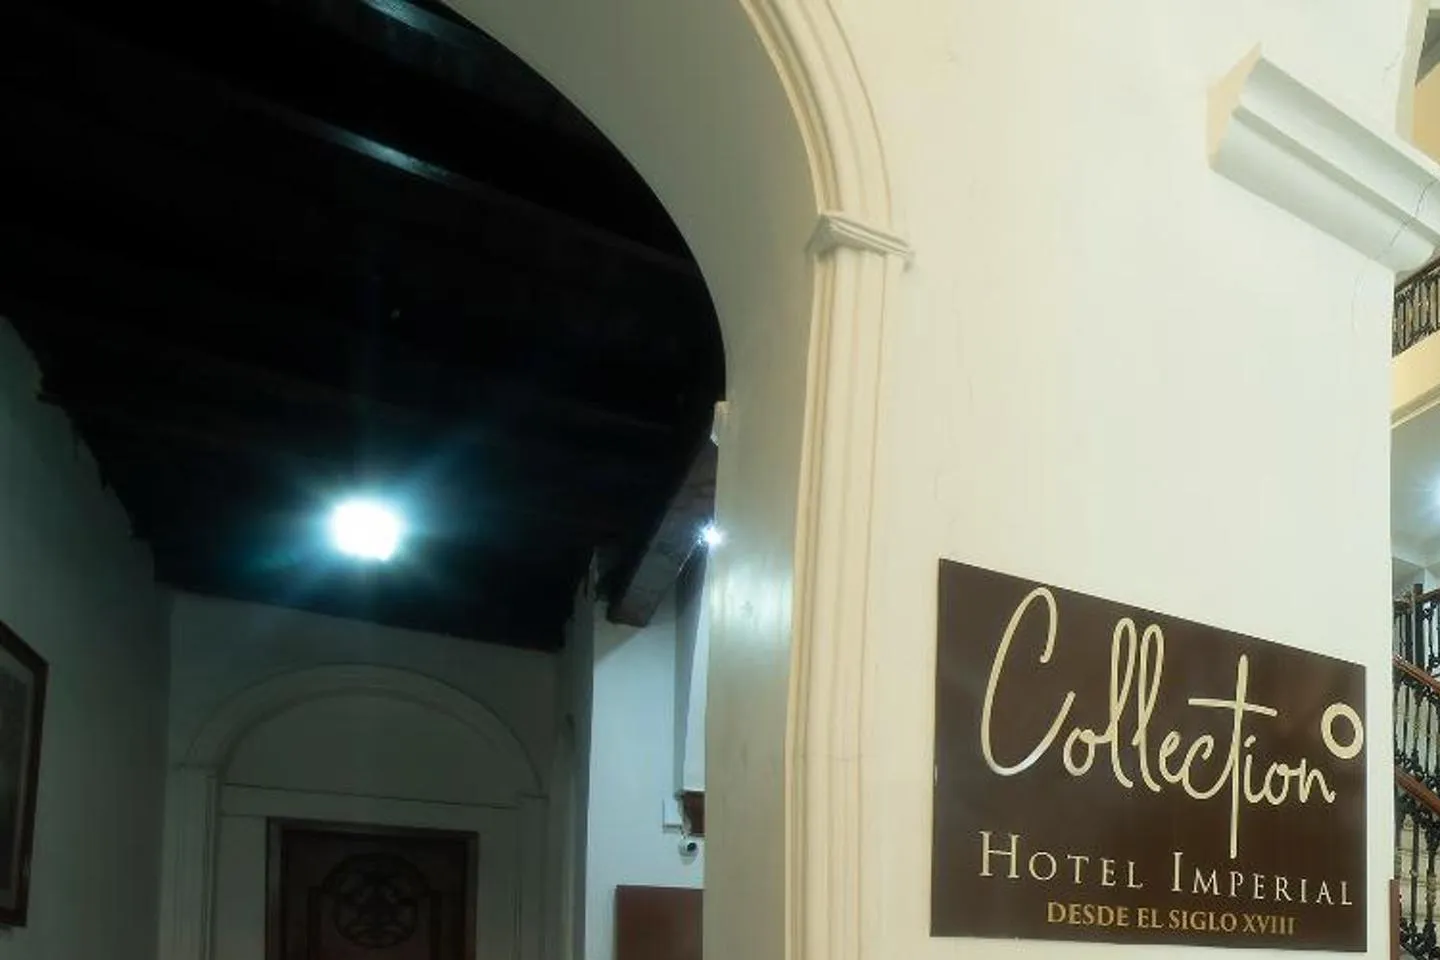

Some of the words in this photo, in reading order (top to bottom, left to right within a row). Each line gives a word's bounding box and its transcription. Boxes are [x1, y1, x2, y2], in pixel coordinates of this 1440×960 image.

[981, 587, 1336, 859] Collection
[1047, 902, 1129, 927] DESDE
[1137, 907, 1164, 929] EL
[1168, 909, 1238, 933] SIGLO
[1243, 914, 1298, 936] XVIII
